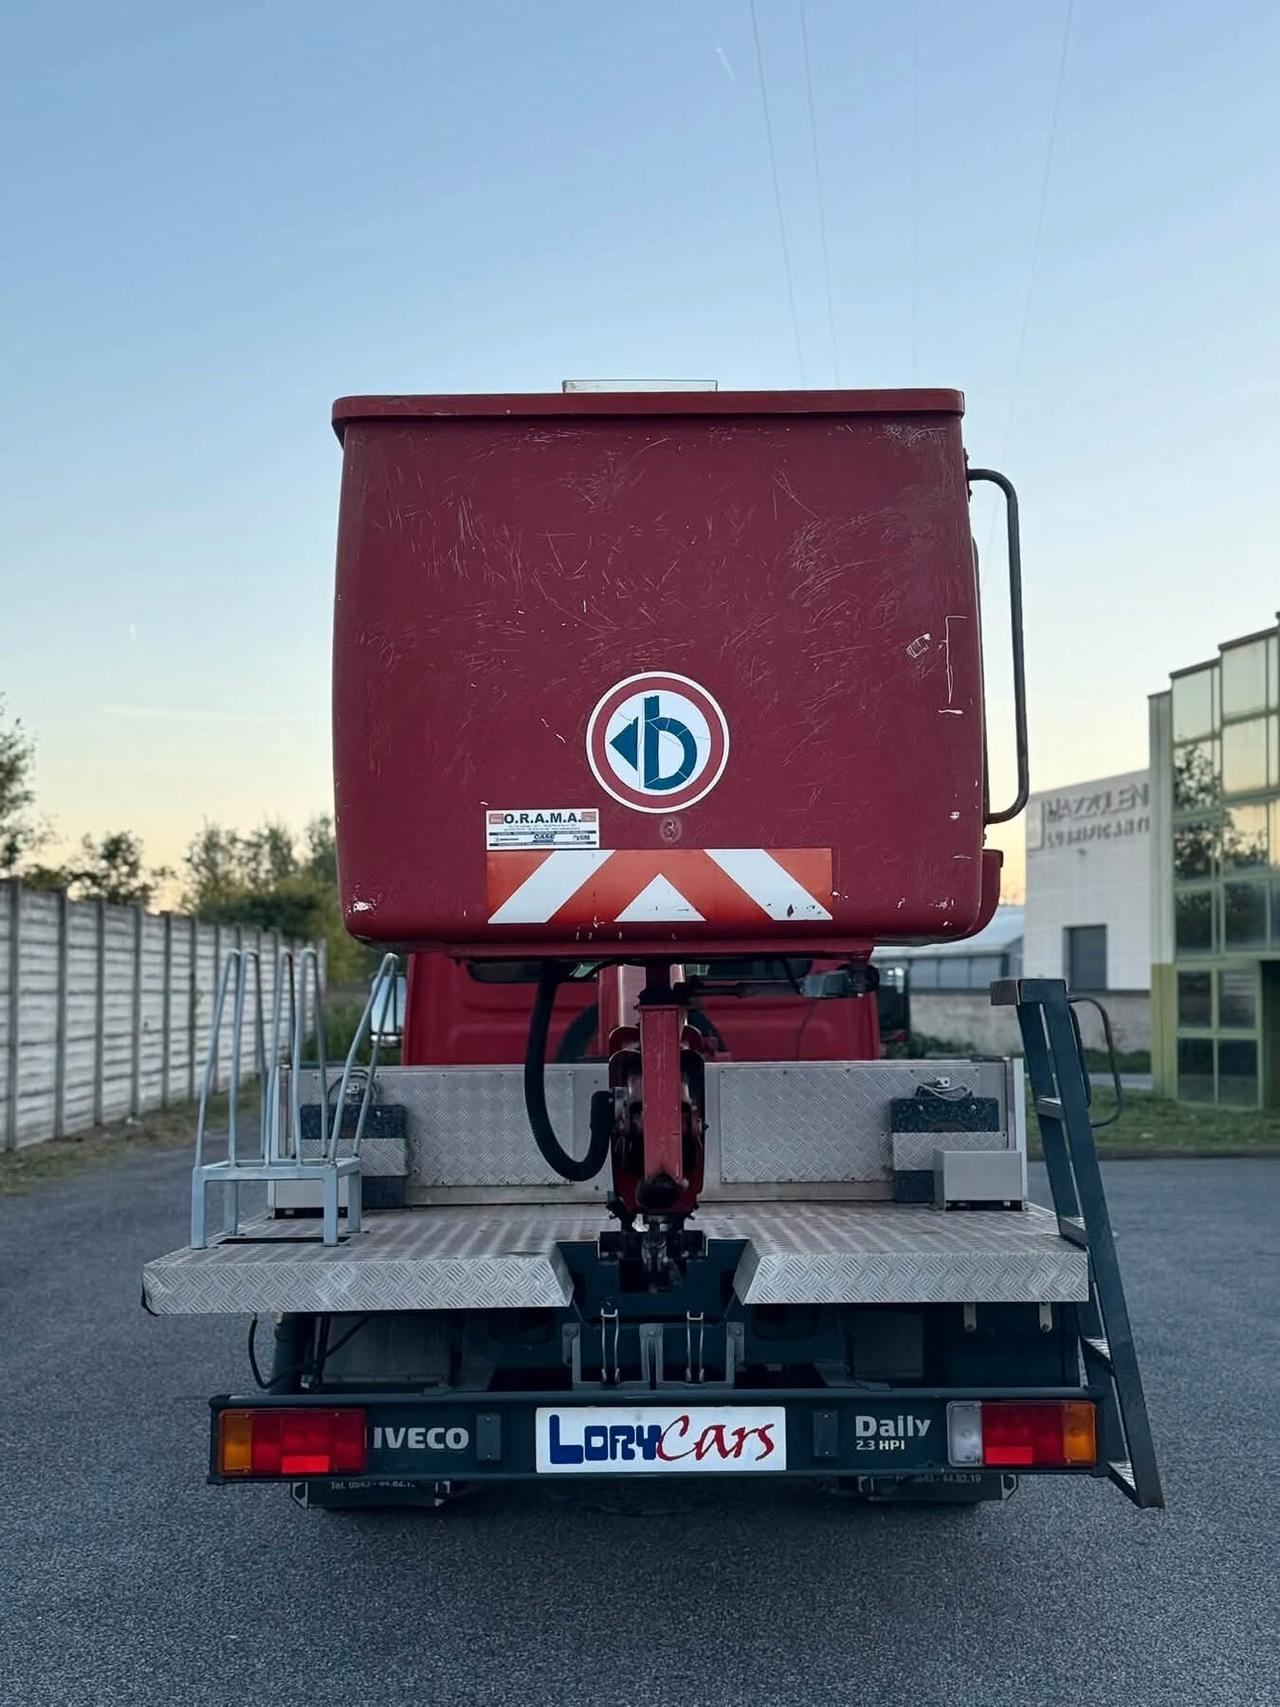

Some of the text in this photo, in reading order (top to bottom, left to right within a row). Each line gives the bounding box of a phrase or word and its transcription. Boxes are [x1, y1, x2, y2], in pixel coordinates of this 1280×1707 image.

[504, 812, 582, 824] O.R.A.M.A.
[855, 1415, 932, 1437] Daily
[373, 1427, 470, 1450] IVECO
[879, 1439, 905, 1450] HPI
